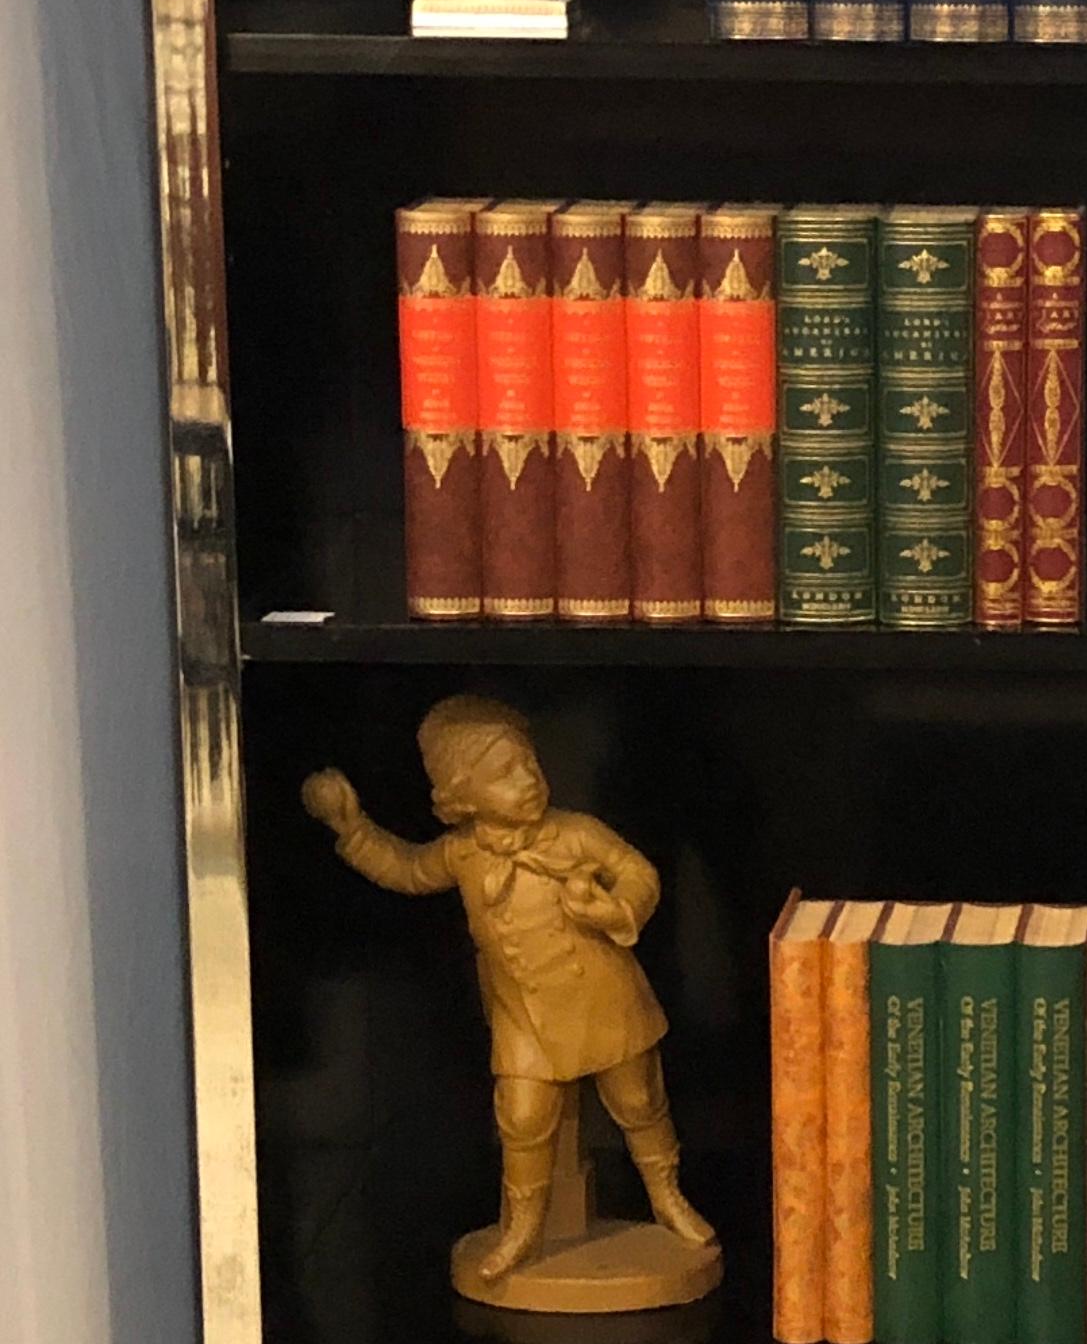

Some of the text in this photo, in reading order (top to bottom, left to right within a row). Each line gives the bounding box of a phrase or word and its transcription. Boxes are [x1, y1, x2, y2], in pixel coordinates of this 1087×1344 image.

[907, 997, 925, 1251] VENETIAN ARCHITECTURE
[979, 997, 998, 1251] VENETIAN ARCHITECTURE
[1051, 997, 1071, 1254] VENETIAN ARCHITECTURE
